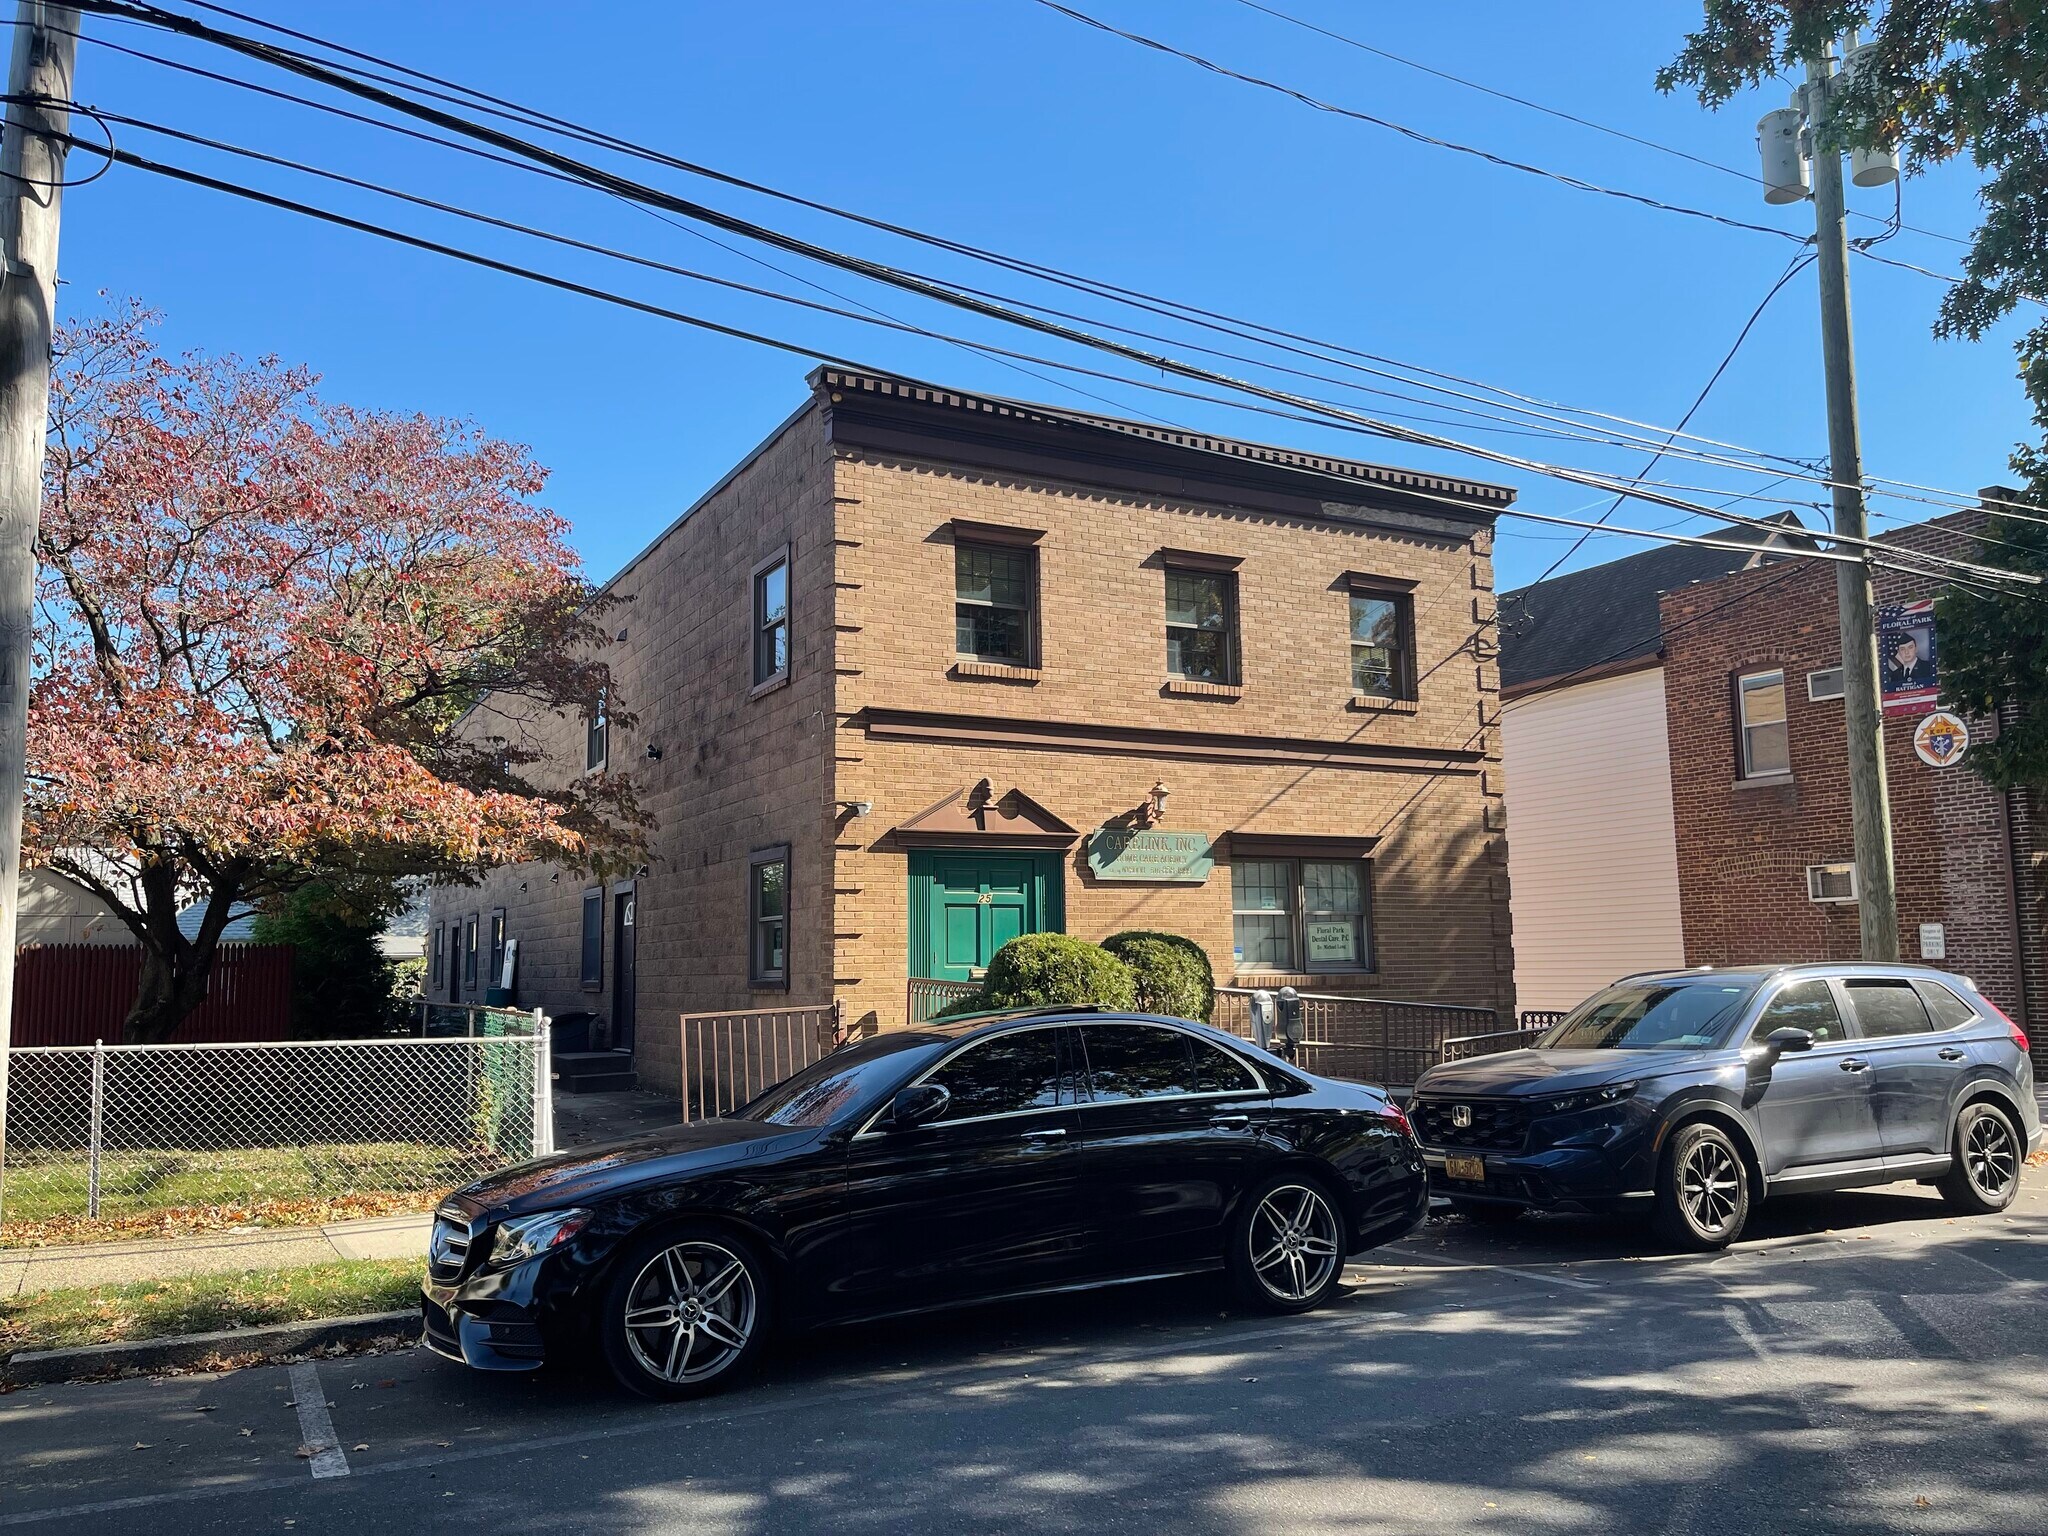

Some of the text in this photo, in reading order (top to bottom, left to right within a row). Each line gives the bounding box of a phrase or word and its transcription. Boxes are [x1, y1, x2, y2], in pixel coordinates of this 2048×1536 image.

[1882, 616, 1932, 630] FLORAL PARK
[1175, 837, 1198, 853] INC.
[1138, 854, 1160, 864] CARE
[1160, 855, 1188, 865] AGENCY
[979, 895, 992, 903] 25
[1332, 926, 1345, 934] Park
